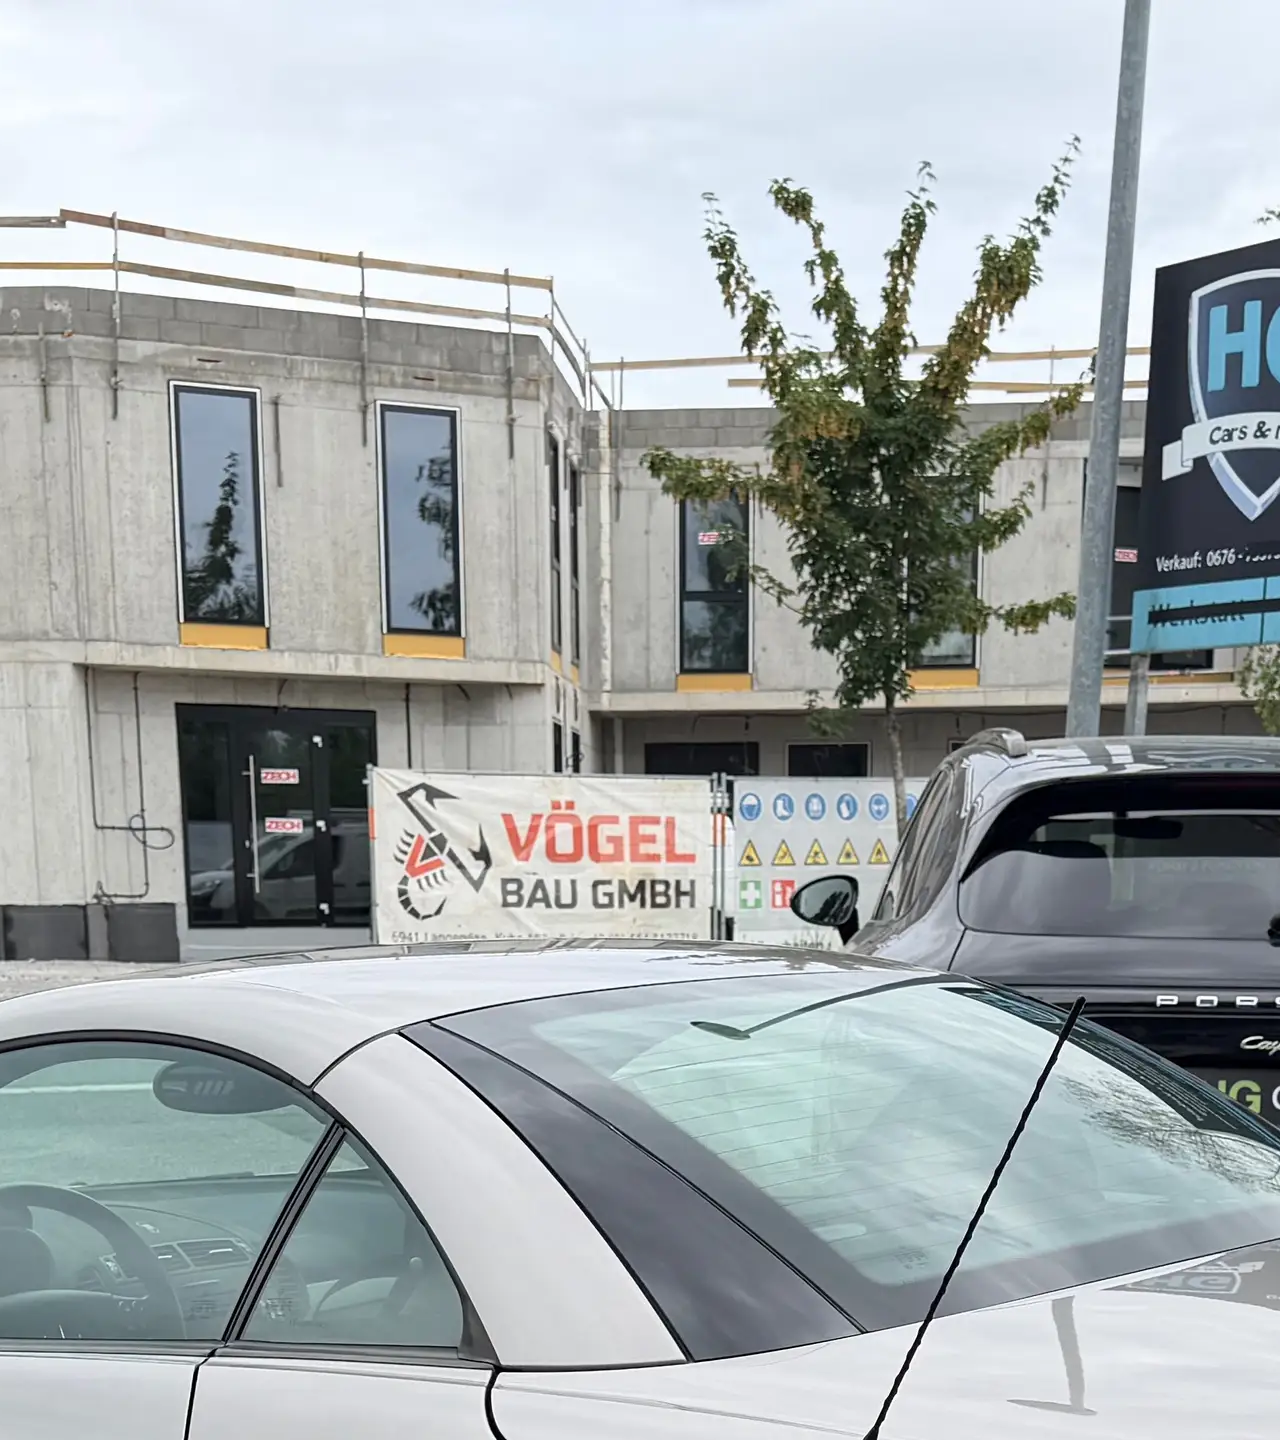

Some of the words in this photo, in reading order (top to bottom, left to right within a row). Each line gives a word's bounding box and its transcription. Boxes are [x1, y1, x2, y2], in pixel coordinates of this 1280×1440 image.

[1209, 424, 1248, 445] Cars
[1253, 421, 1271, 439] &
[1155, 551, 1202, 573] Verkauf:
[1206, 548, 1236, 567] 0676
[500, 799, 697, 865] VÖGEL
[500, 877, 579, 910] BAU
[591, 877, 697, 910] GMBH
